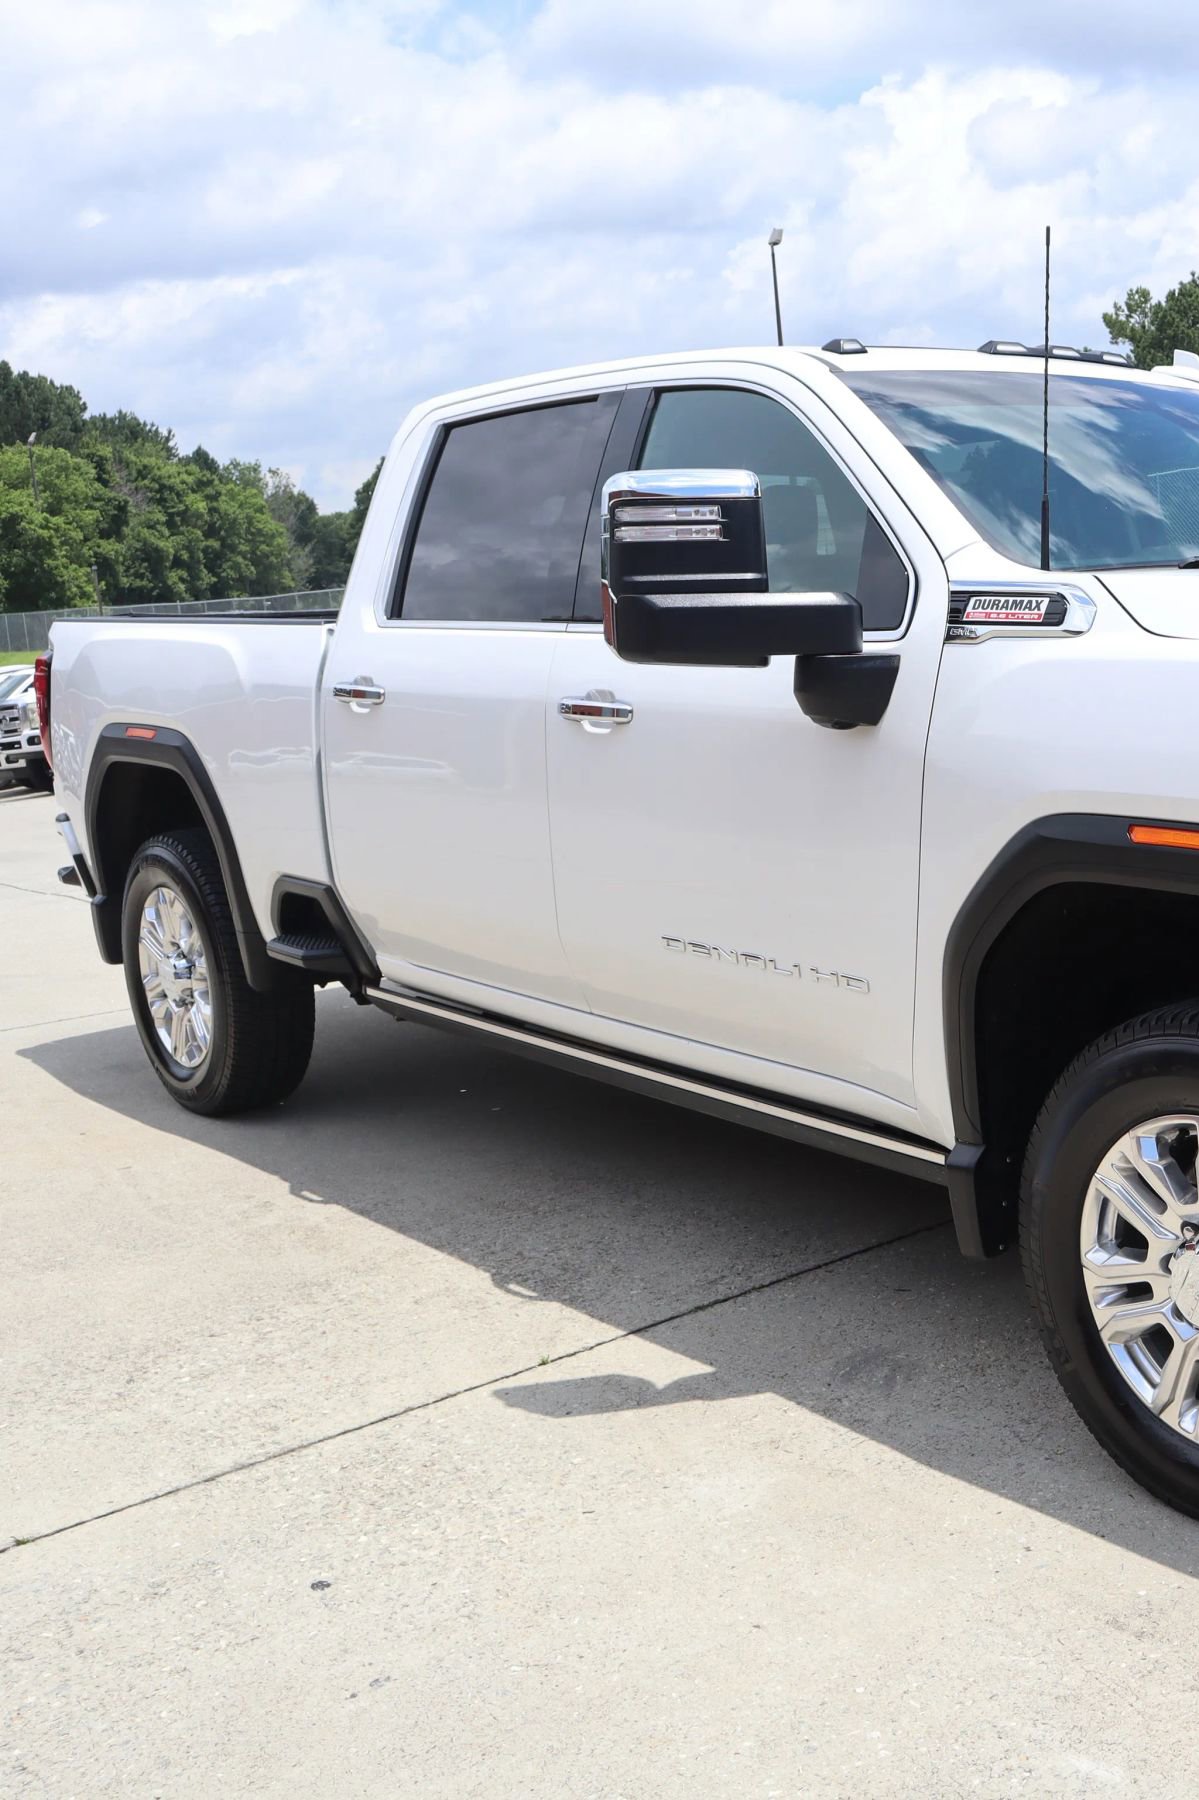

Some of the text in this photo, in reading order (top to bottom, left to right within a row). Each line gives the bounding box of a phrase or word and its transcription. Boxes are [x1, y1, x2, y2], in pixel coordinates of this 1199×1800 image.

[971, 598, 1045, 612] DURAMAX
[661, 934, 871, 993] DENALI HD
